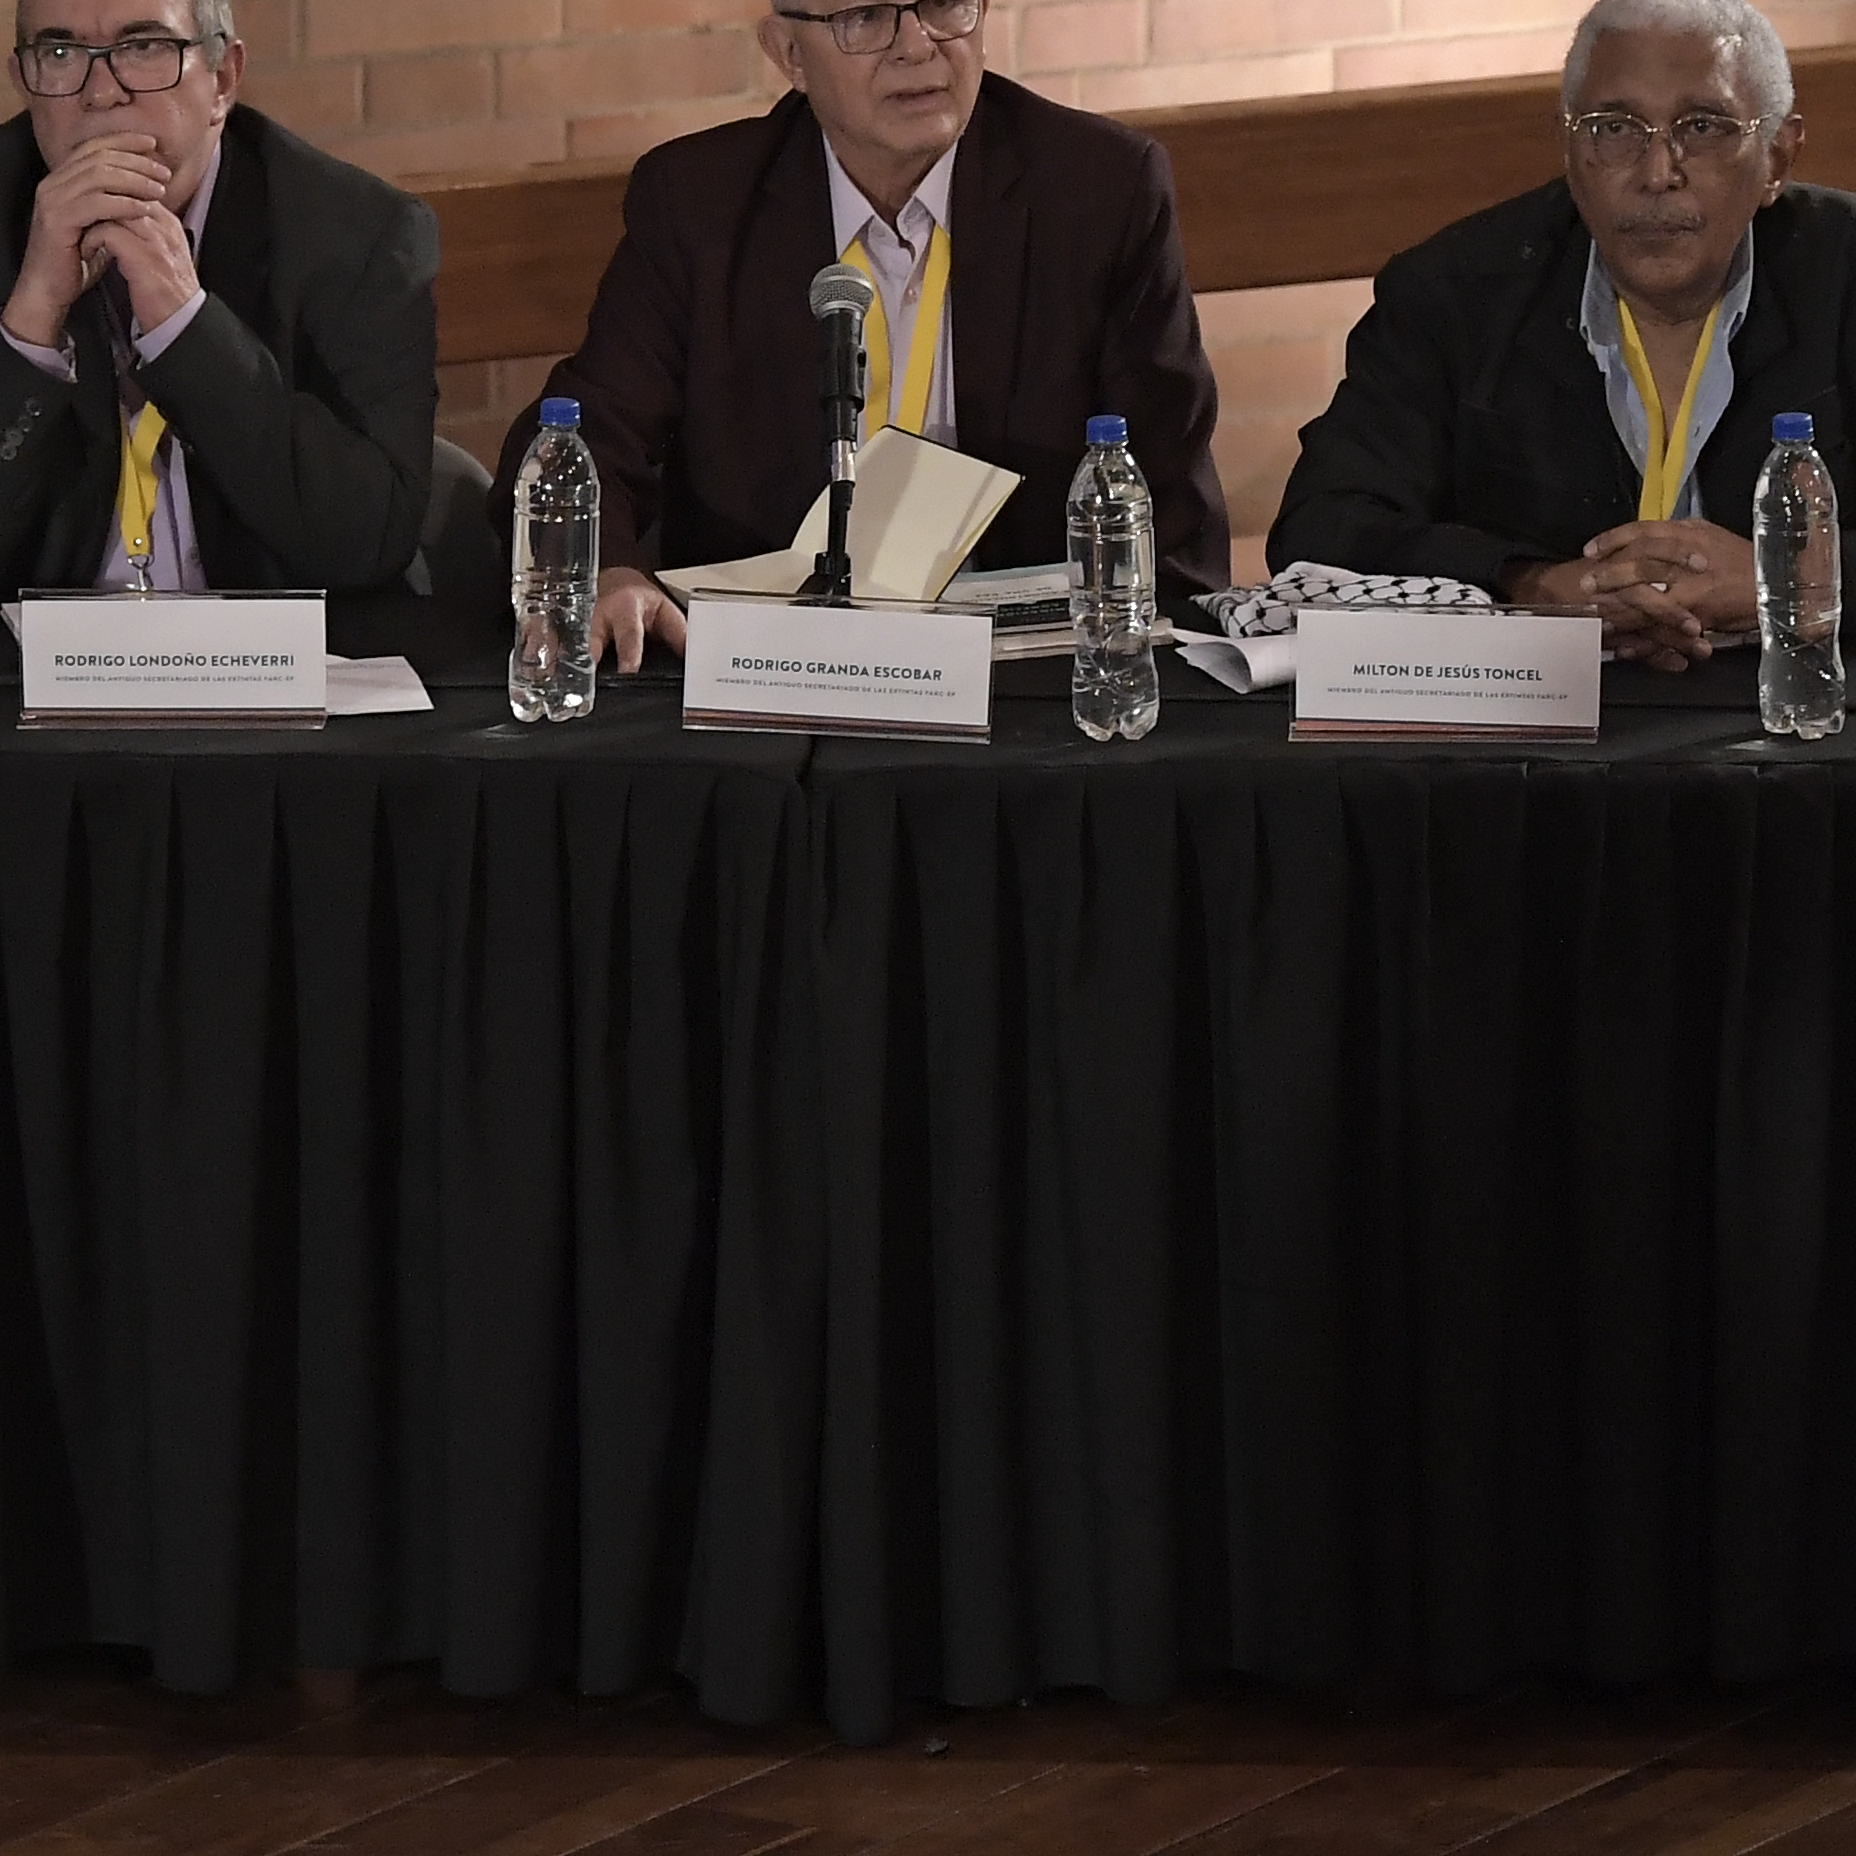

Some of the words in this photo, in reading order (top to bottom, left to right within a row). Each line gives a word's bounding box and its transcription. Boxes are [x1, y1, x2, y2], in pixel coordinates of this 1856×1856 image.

[55, 655, 125, 666] RODRIGO
[130, 653, 207, 666] LONDOÑO
[211, 655, 294, 666] ECHEVERRI
[732, 657, 802, 672] RODRIGO
[806, 662, 869, 677] GRANDA
[874, 666, 942, 681] ESCOBAR
[1353, 664, 1409, 676] MILTON
[1414, 666, 1433, 677] DE
[1437, 664, 1480, 679] JESÚS
[1484, 668, 1543, 681] TONCEL
